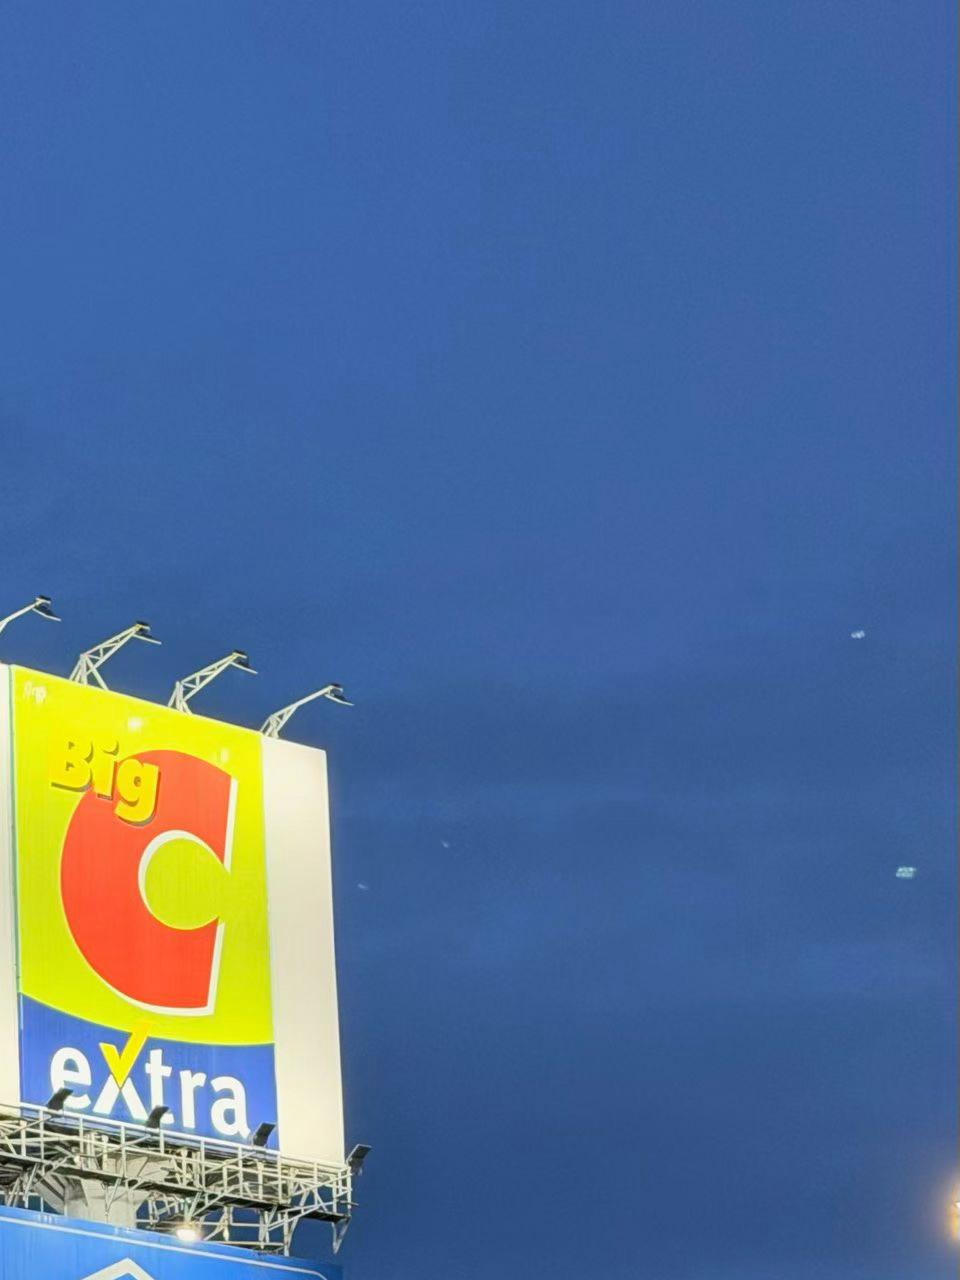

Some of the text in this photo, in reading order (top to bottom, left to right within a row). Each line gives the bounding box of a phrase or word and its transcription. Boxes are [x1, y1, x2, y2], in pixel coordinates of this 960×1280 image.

[50, 735, 161, 827] Big
[58, 748, 239, 1018] C
[50, 1023, 252, 1139] extra
